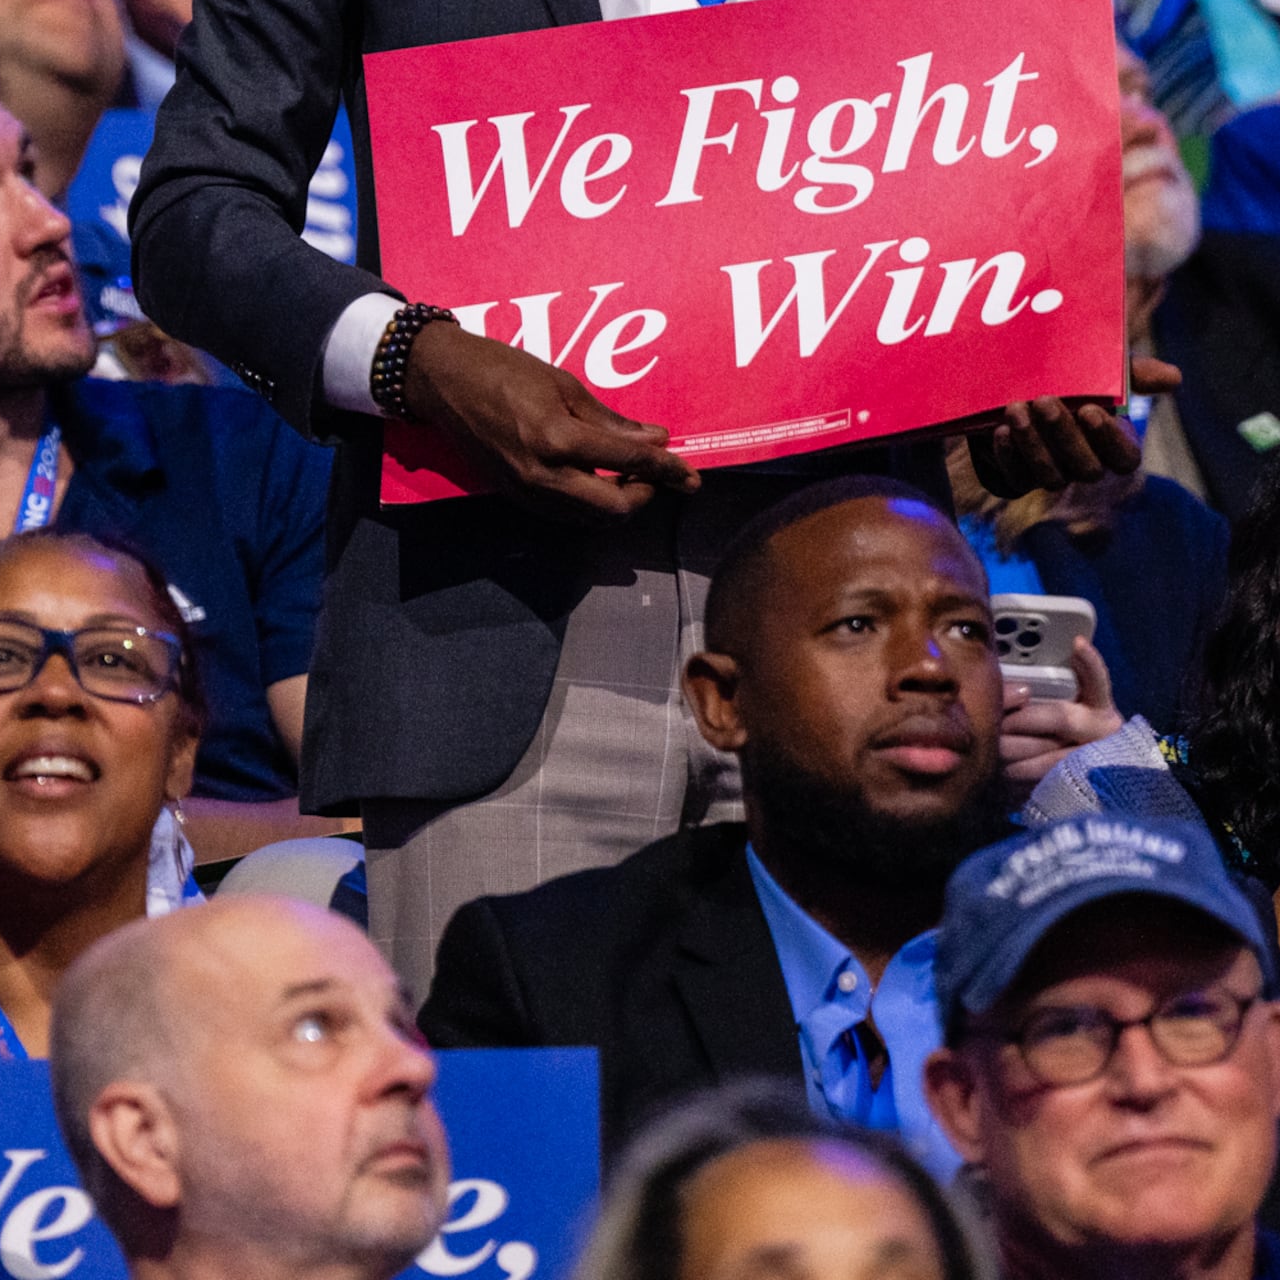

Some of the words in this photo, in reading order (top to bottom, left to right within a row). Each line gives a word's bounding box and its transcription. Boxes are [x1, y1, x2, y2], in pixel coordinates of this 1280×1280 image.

[431, 103, 632, 237] We
[655, 52, 1059, 215] Fight,
[450, 281, 667, 390] We
[720, 237, 1063, 368] Win.
